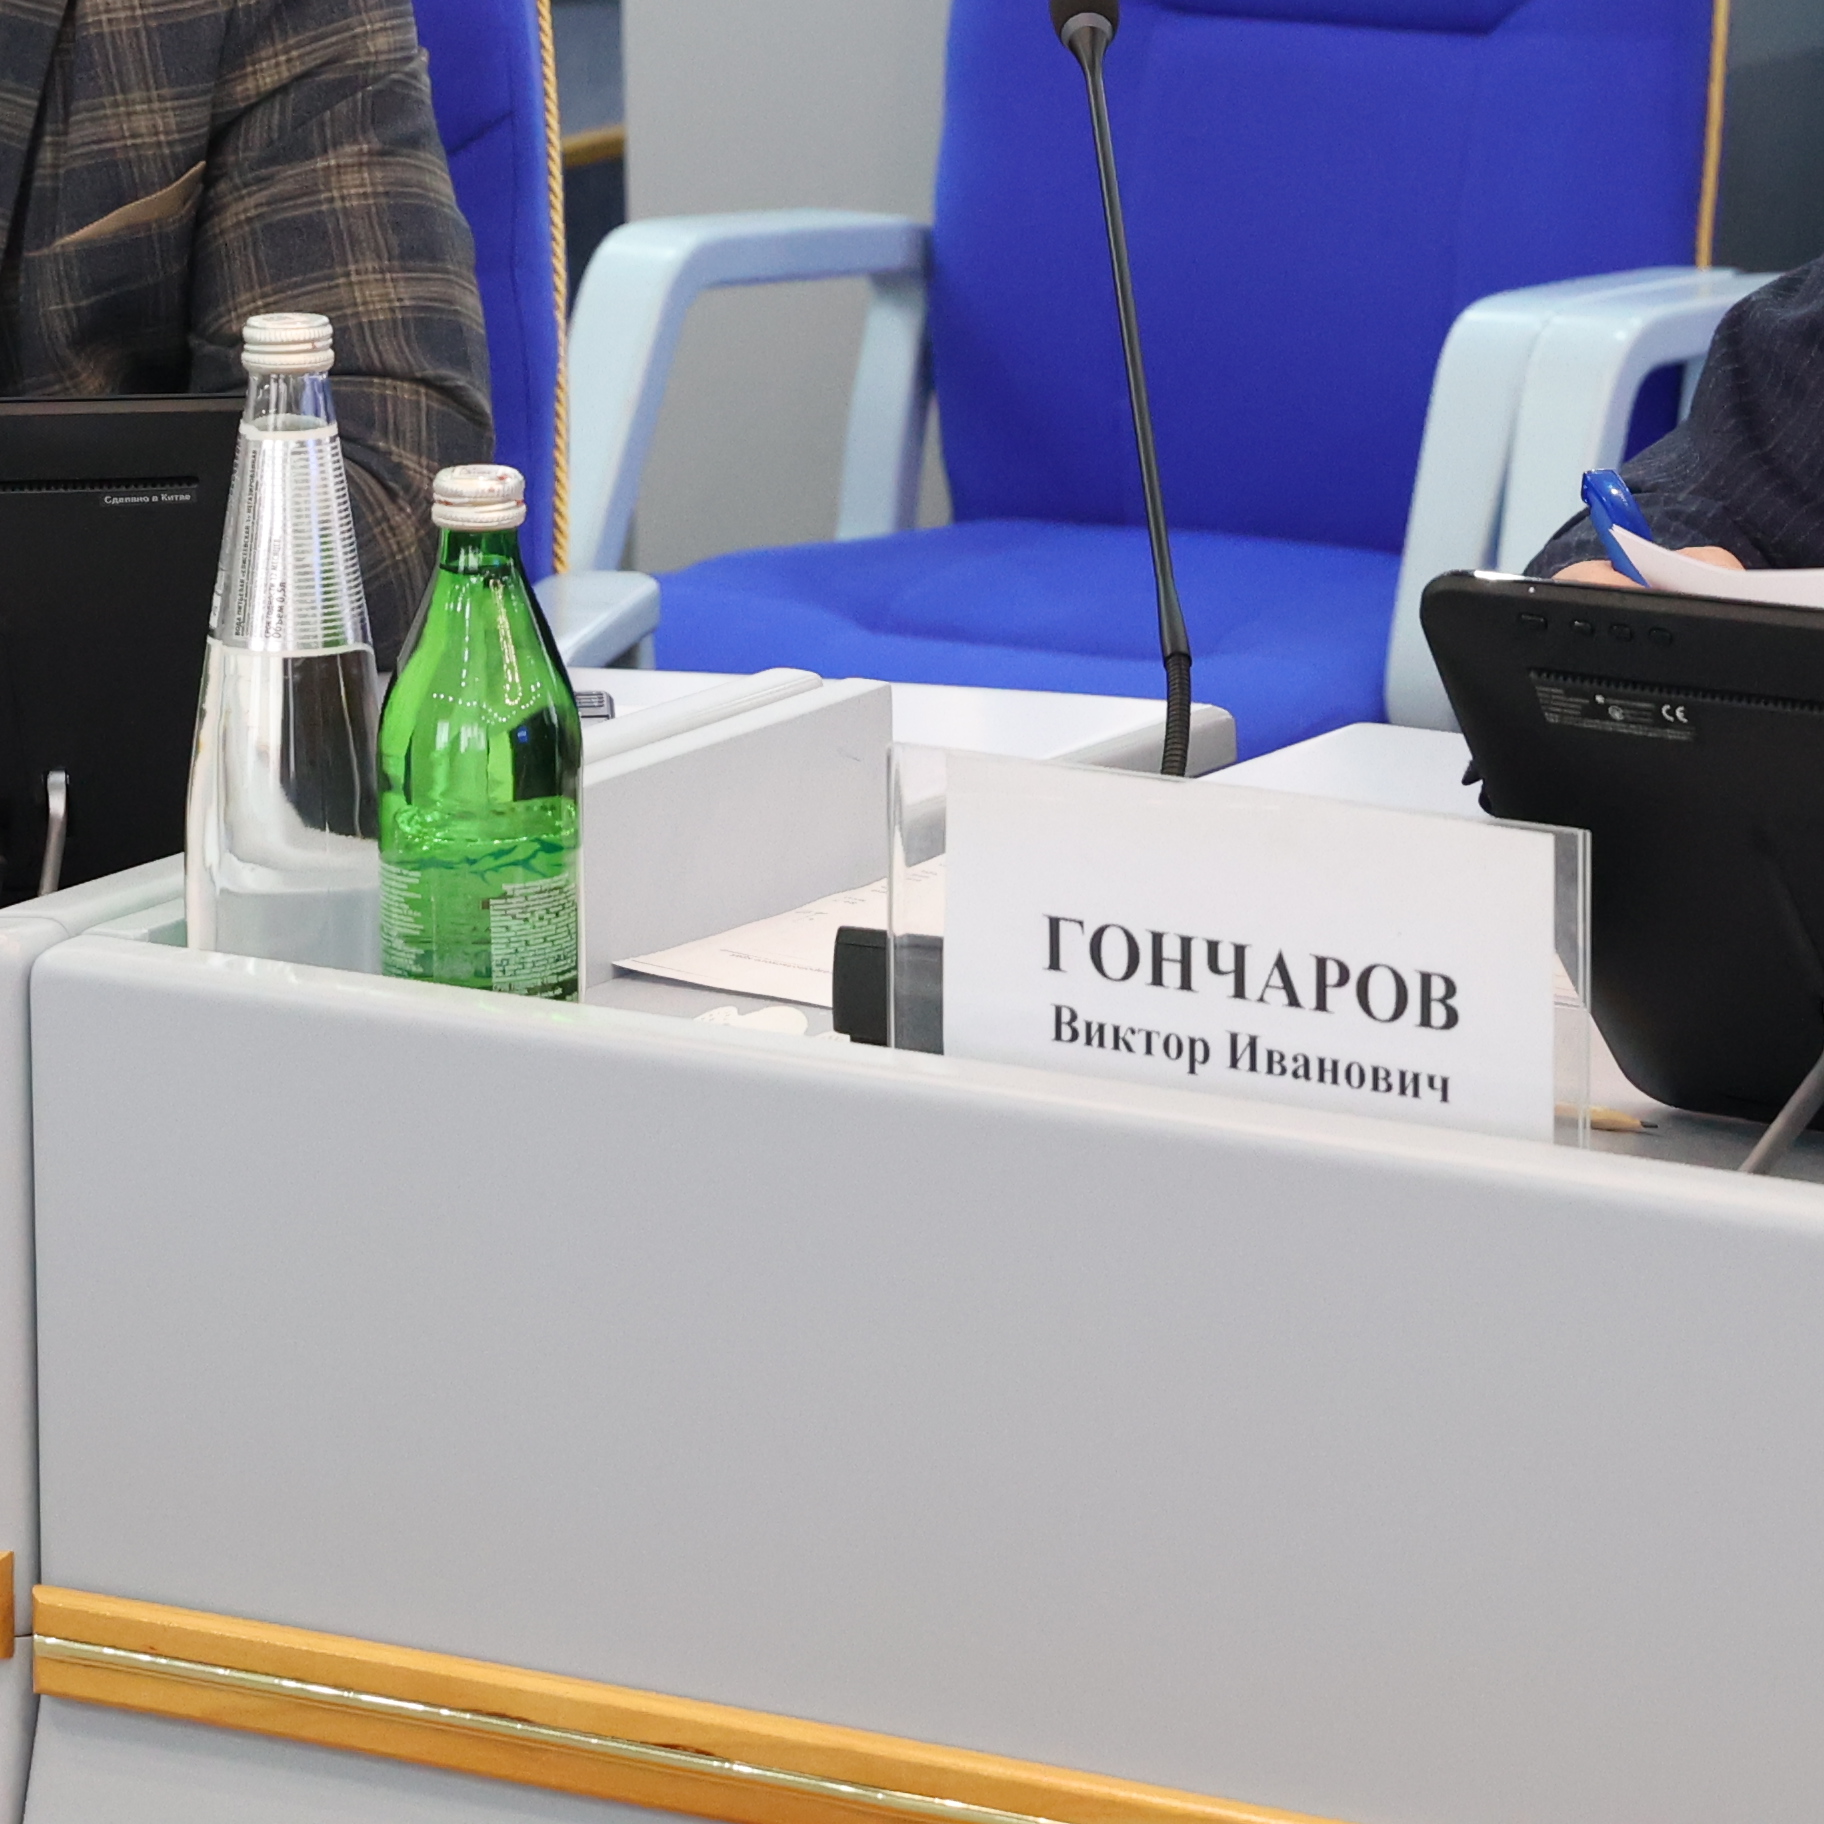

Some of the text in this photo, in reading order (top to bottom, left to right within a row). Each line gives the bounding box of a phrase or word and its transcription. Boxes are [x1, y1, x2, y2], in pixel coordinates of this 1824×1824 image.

[1043, 914, 1460, 1031] ГОНЧАРОВ
[1051, 1003, 1451, 1104] Виктор Иванович
